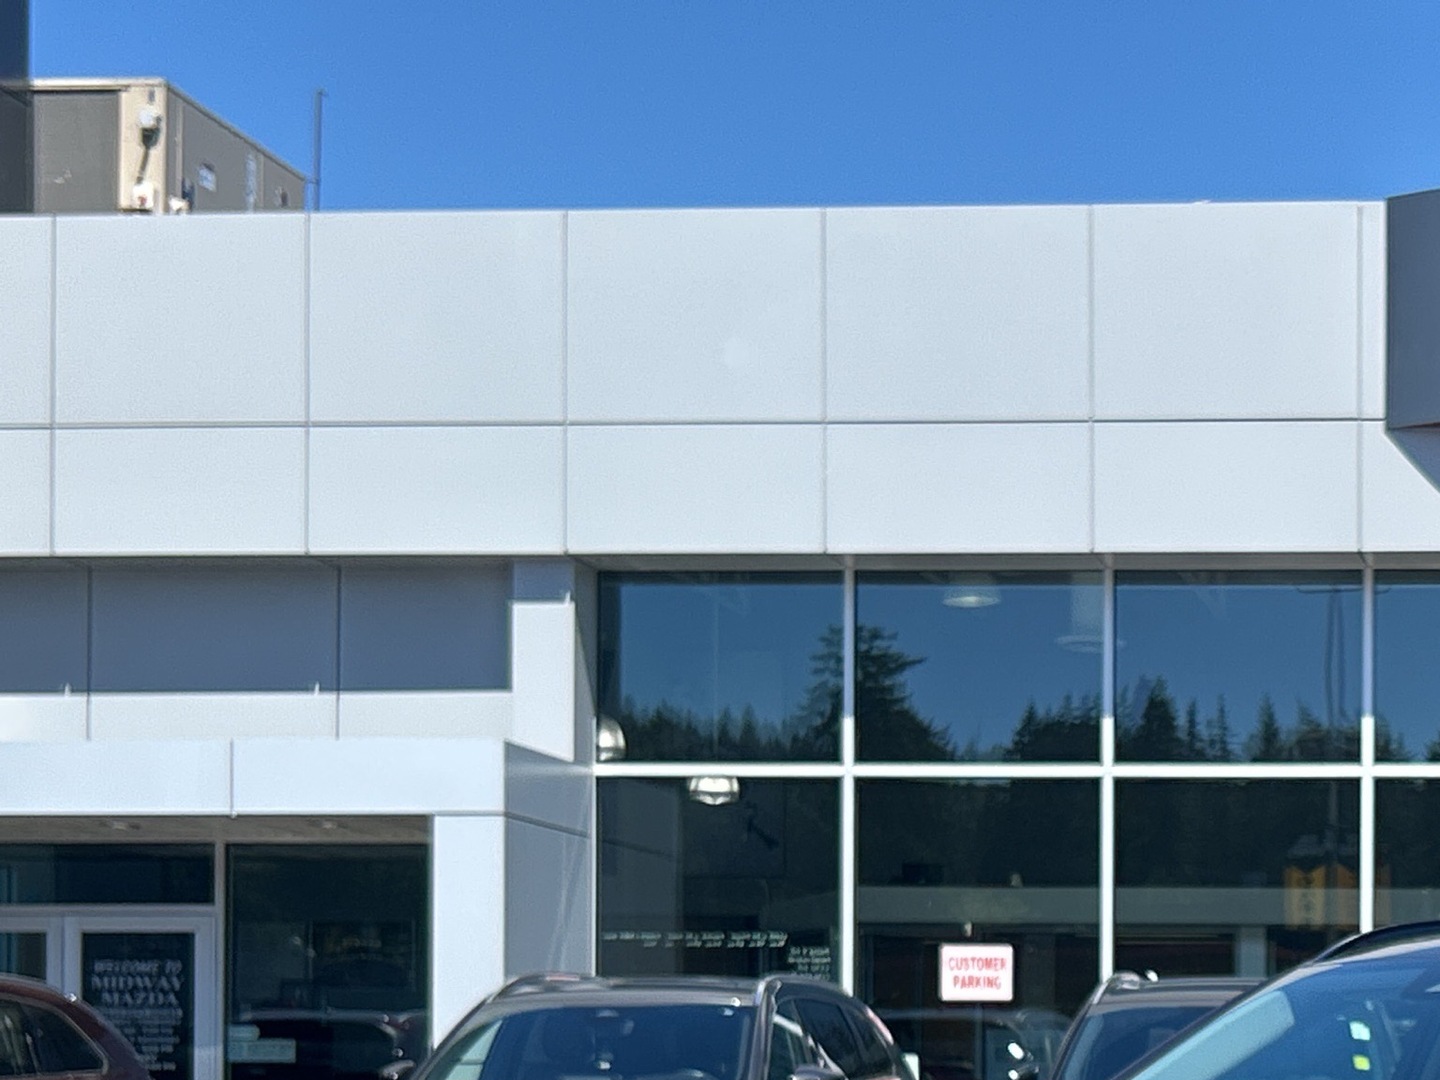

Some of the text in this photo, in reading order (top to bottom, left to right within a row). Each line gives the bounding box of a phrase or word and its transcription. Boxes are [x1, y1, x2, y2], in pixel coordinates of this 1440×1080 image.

[948, 956, 1008, 972] CUSTOMER
[91, 974, 184, 992] MIDWAY
[952, 975, 1002, 990] PARKING
[101, 991, 180, 1006] MAZDA
